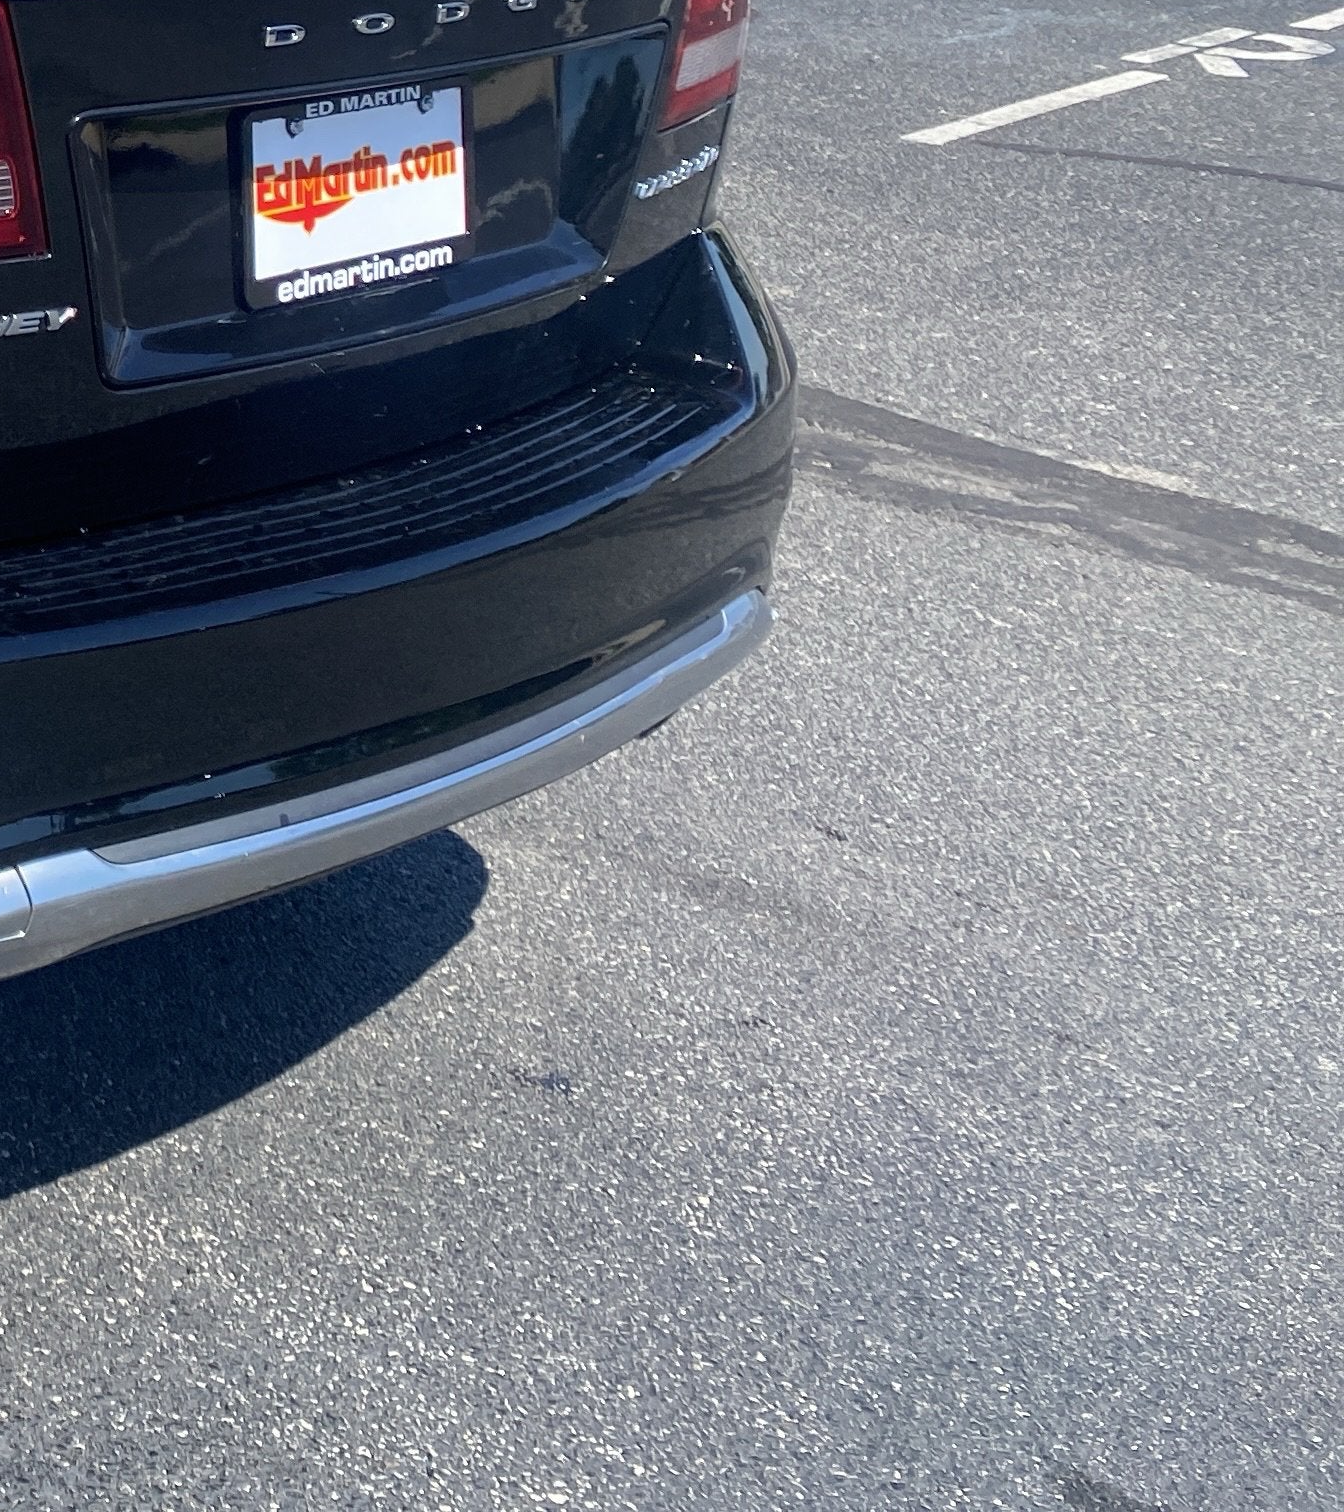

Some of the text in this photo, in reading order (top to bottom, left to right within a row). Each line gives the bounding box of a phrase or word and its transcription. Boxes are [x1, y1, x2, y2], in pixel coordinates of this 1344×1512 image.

[305, 85, 422, 118] ED MARTIN
[255, 140, 457, 212] EdMartin.com
[277, 245, 454, 303] edmartin.com
